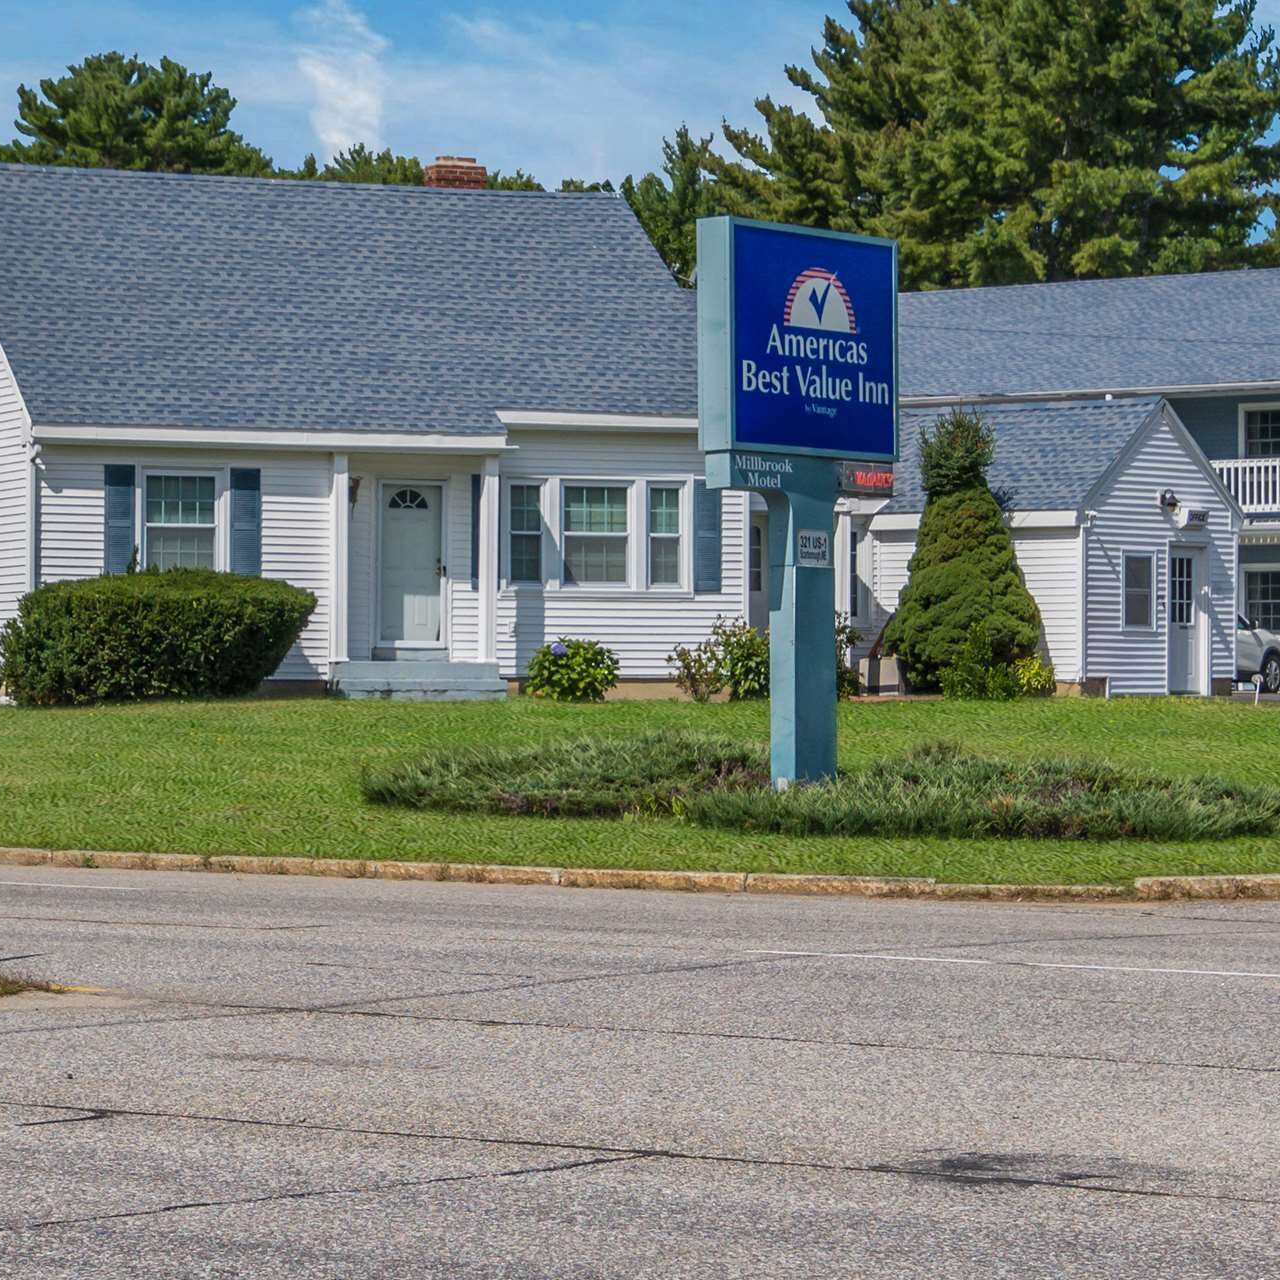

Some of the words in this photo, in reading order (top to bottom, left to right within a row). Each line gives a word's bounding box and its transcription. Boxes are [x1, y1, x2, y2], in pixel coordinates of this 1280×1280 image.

[766, 323, 868, 365] Americas
[742, 359, 790, 395] Best
[795, 364, 852, 401] Value
[858, 371, 889, 405] Inn
[734, 454, 793, 473] Millbrook
[747, 471, 781, 488] Motel
[800, 535, 811, 549] 321
[812, 535, 827, 550] US-1
